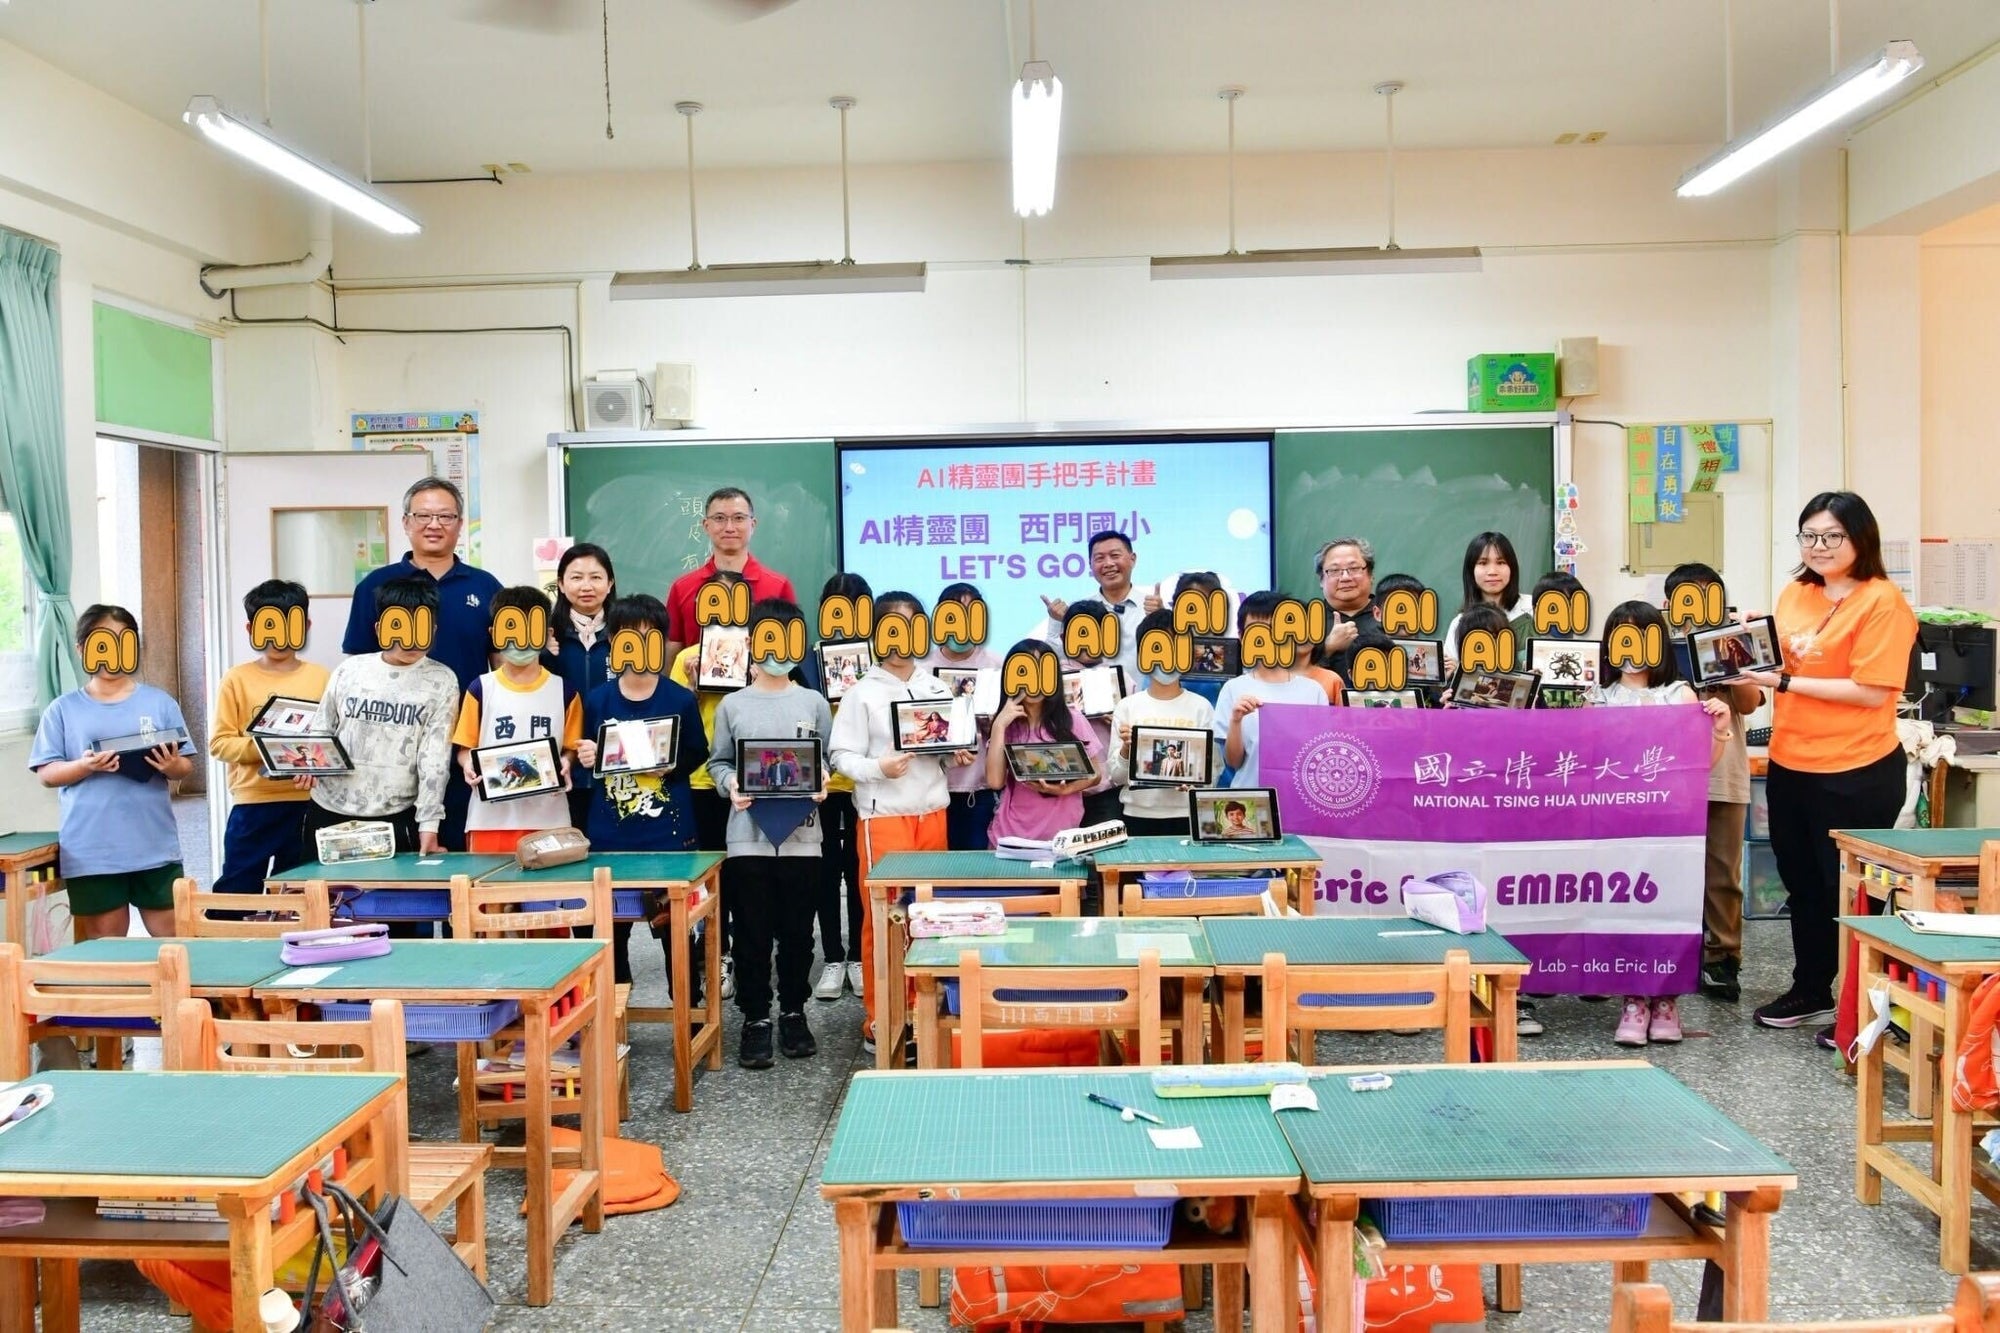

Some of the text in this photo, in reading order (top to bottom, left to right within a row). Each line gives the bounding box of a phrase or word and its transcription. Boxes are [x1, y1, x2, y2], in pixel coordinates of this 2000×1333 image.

[917, 460, 1157, 490] AI精靈團手把手計畫
[1660, 427, 1679, 519] 自在勇敢
[859, 510, 1151, 546] AI精靈團 西門國小
[941, 553, 1093, 580] LET'S GO
[1414, 746, 1675, 789] 國立清華大學
[1413, 791, 1671, 808] NATIONAL TSING HUA UNIVERSITY
[1497, 872, 1658, 905] EMBA26
[1538, 958, 1566, 973] Lab
[1583, 959, 1610, 973] aka
[1615, 958, 1648, 973] Eric
[1653, 959, 1676, 974] lab
